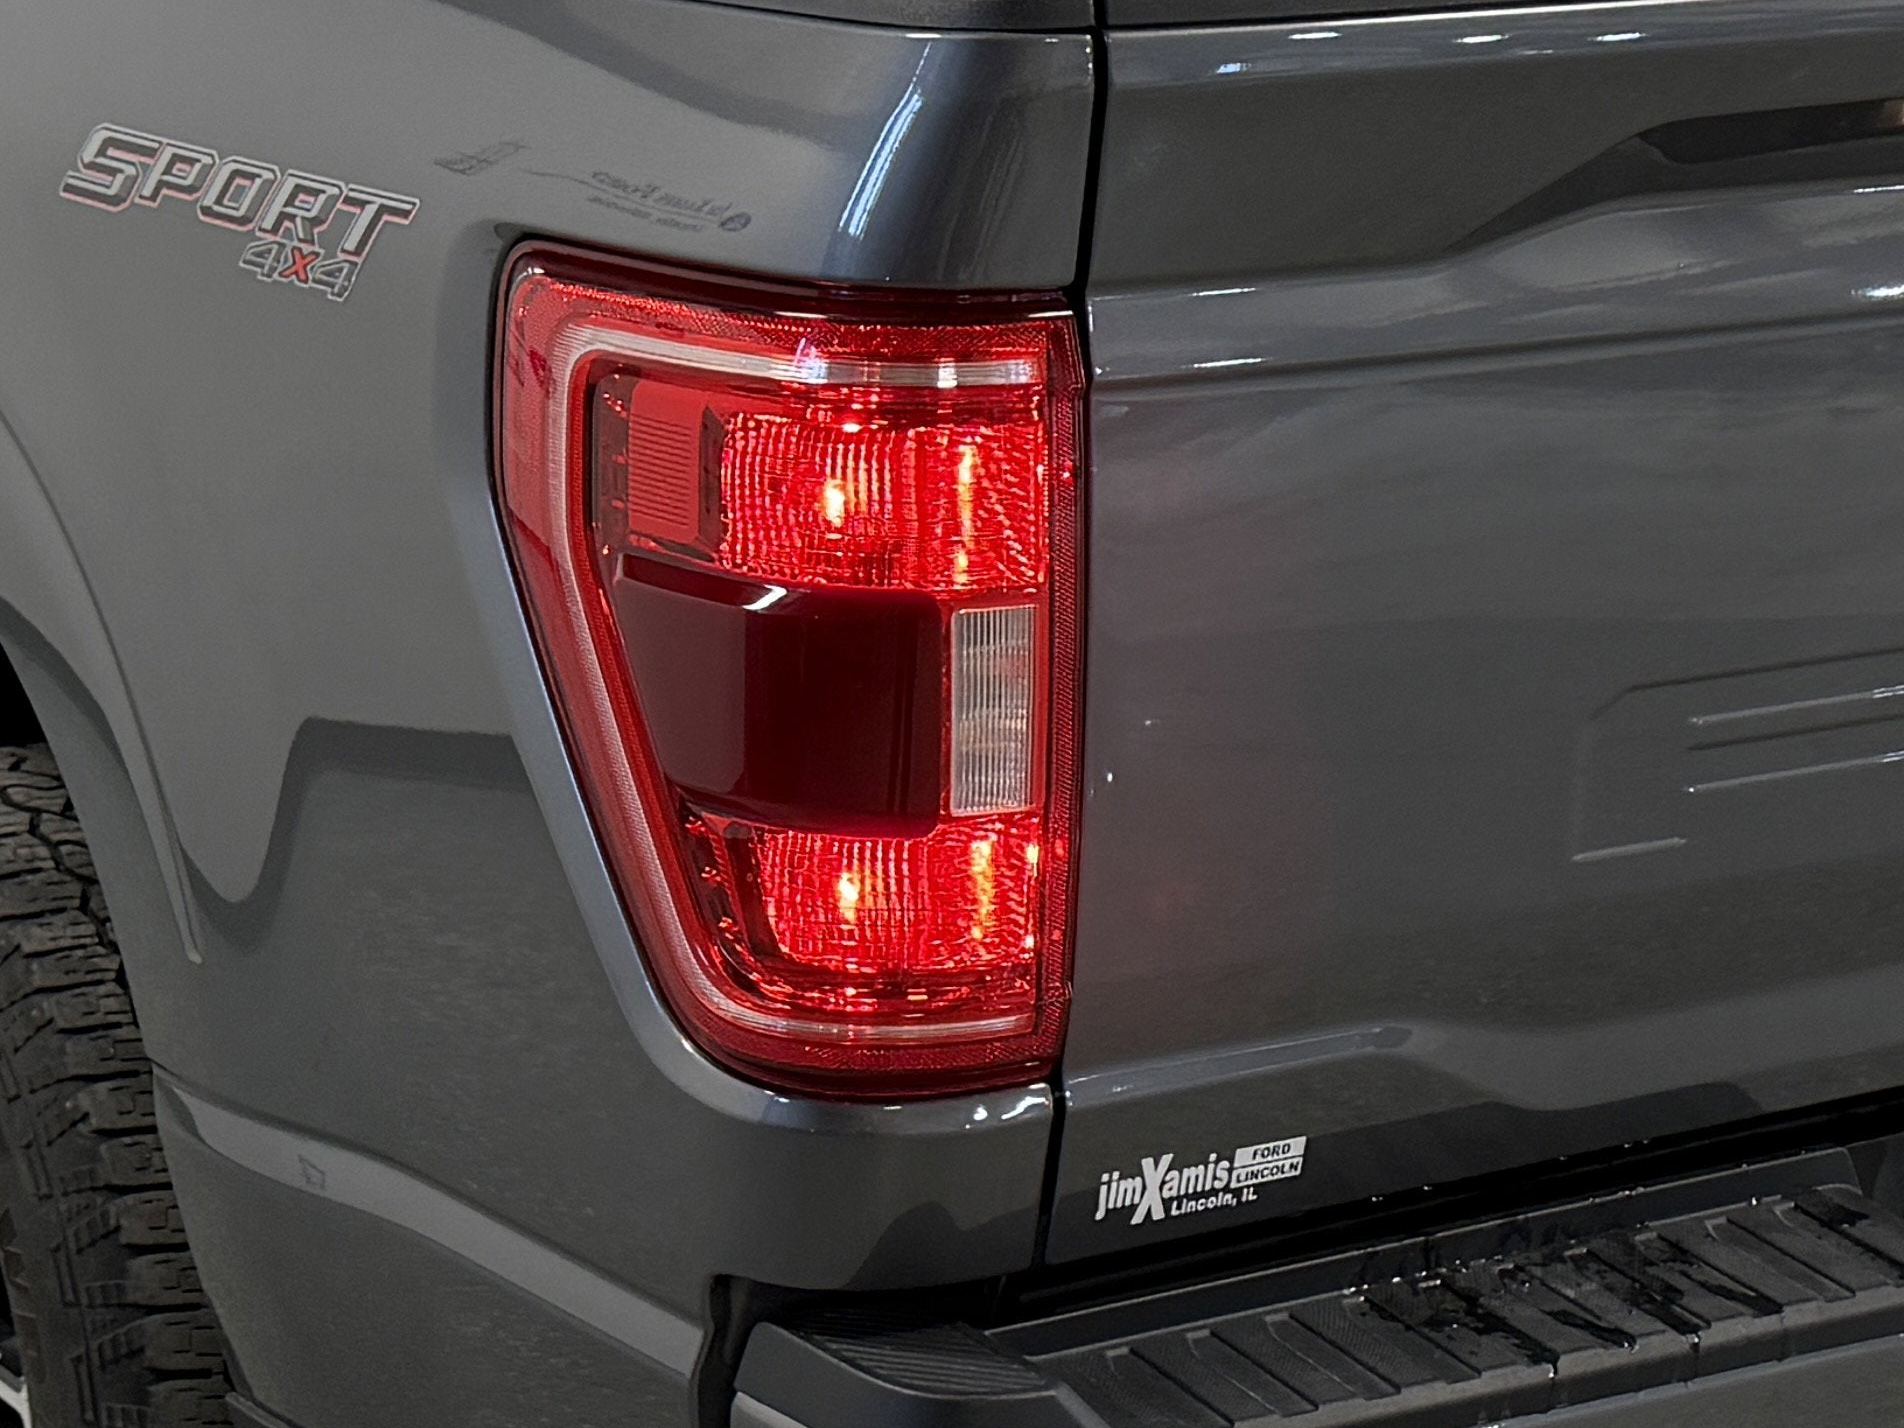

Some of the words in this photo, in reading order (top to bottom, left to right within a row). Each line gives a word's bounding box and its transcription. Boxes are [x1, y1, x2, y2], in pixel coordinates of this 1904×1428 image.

[58, 121, 421, 260] SPORT
[1252, 1143, 1291, 1160] FORD
[1235, 1161, 1300, 1185] LINCOLN
[1171, 1191, 1237, 1217] Lincoln,
[1242, 1186, 1258, 1202] IL
